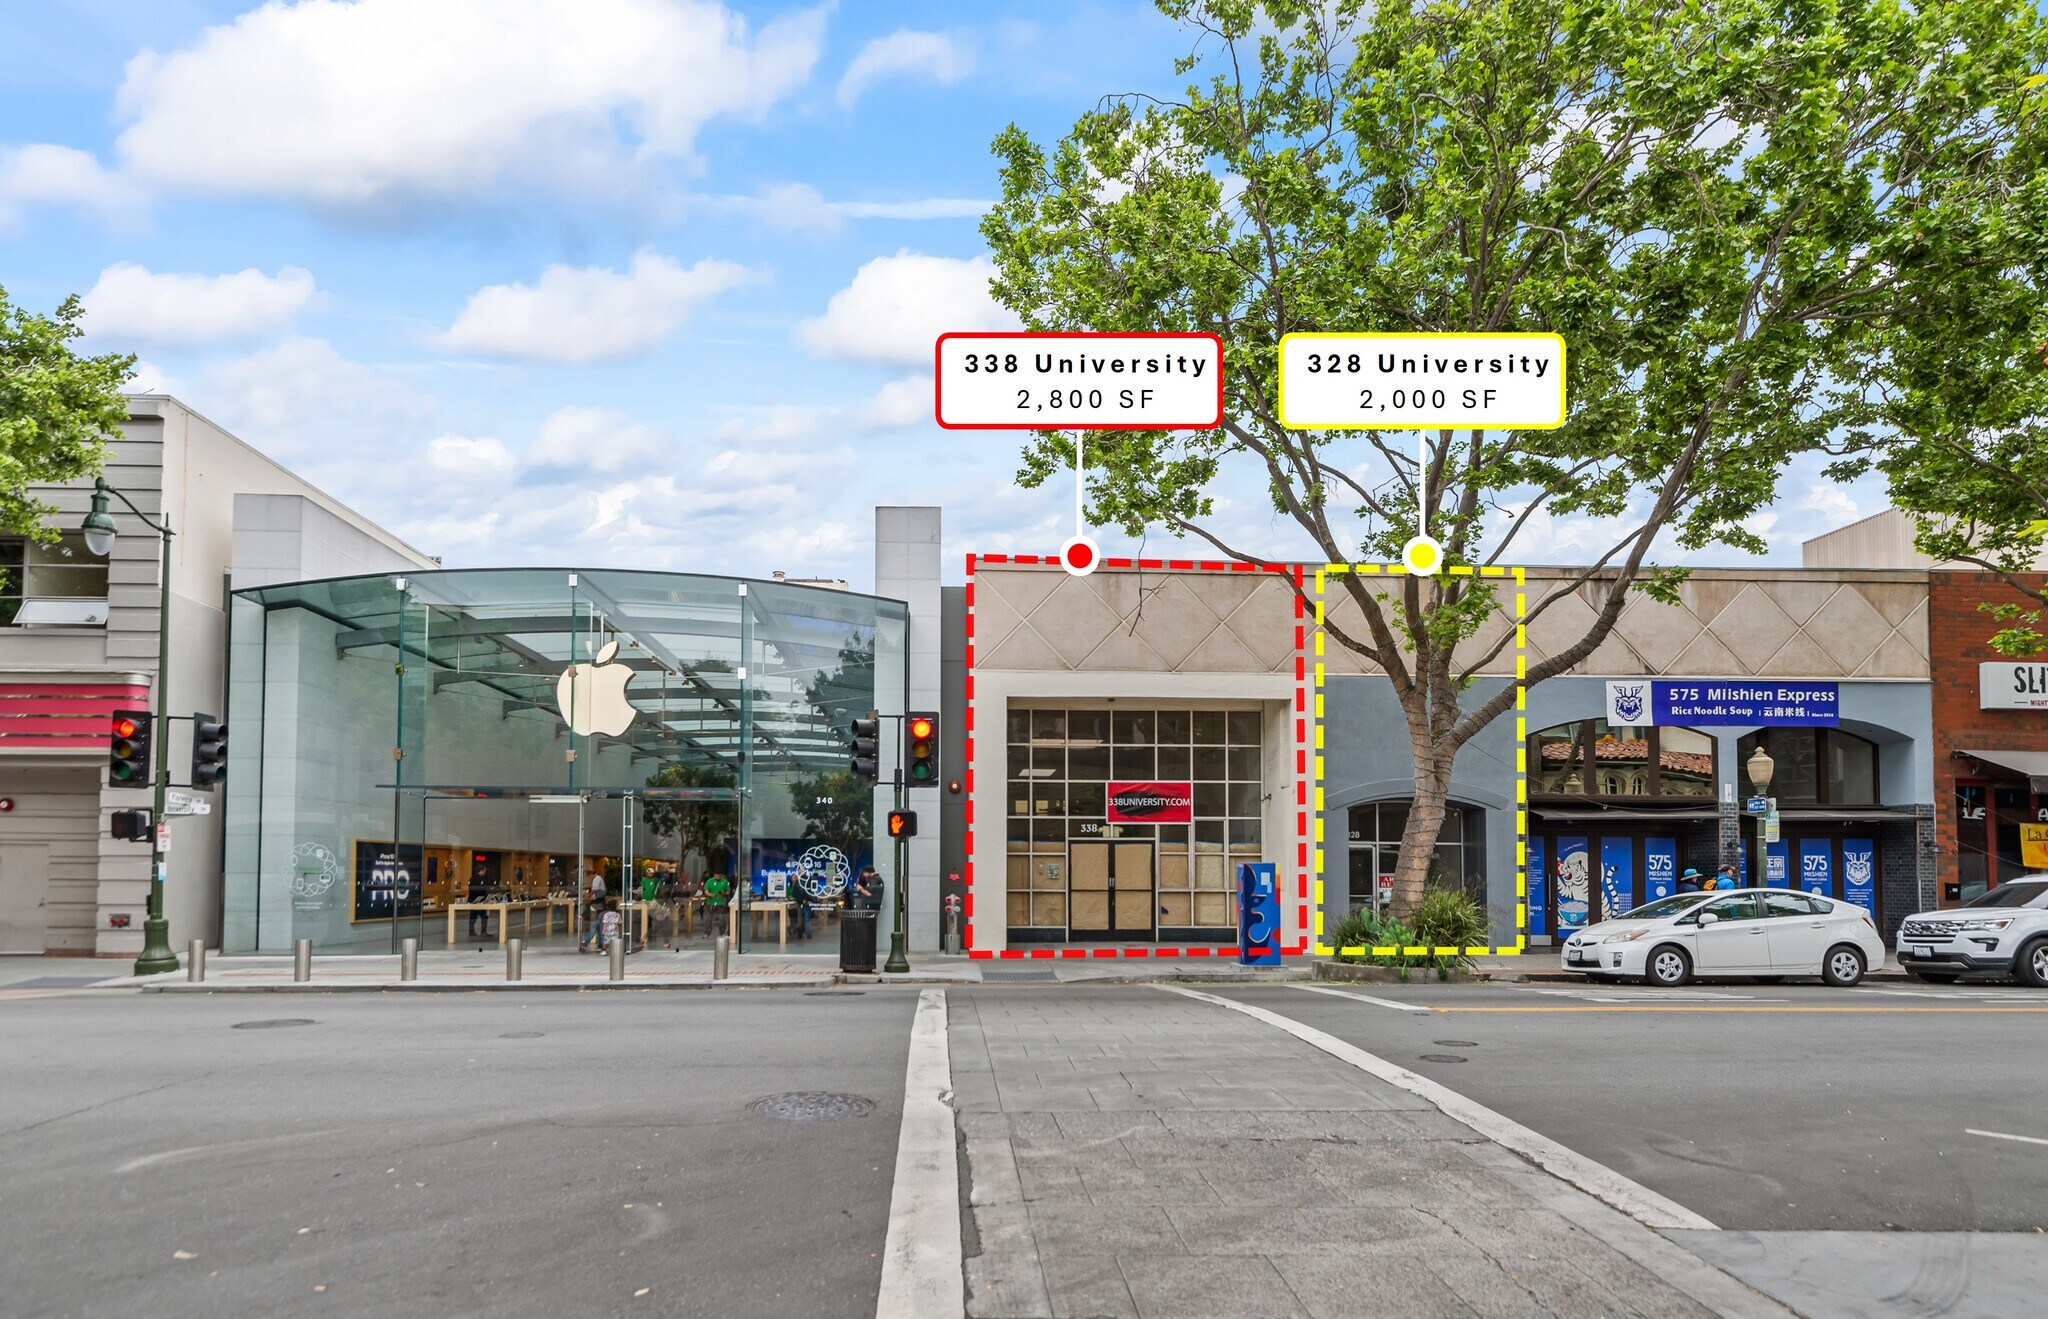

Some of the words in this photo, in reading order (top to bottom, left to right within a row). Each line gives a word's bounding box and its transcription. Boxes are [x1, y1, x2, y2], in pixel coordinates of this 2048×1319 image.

[2014, 666, 2048, 693] SLI
[1669, 688, 1699, 701] 575
[1708, 688, 1773, 701] Miishien
[1777, 689, 1835, 704] Express
[1671, 706, 1692, 715] Rice
[1694, 706, 1727, 715] Noodle
[1729, 706, 1753, 717] Soup
[1763, 706, 1805, 717] 云南米线
[816, 796, 833, 805] 340
[1108, 797, 1191, 806] 338UNIVERSITY.COM
[1080, 823, 1098, 832] 338
[1349, 831, 1360, 839] 28
[1648, 854, 1673, 871] 575
[1803, 855, 1828, 871] 575
